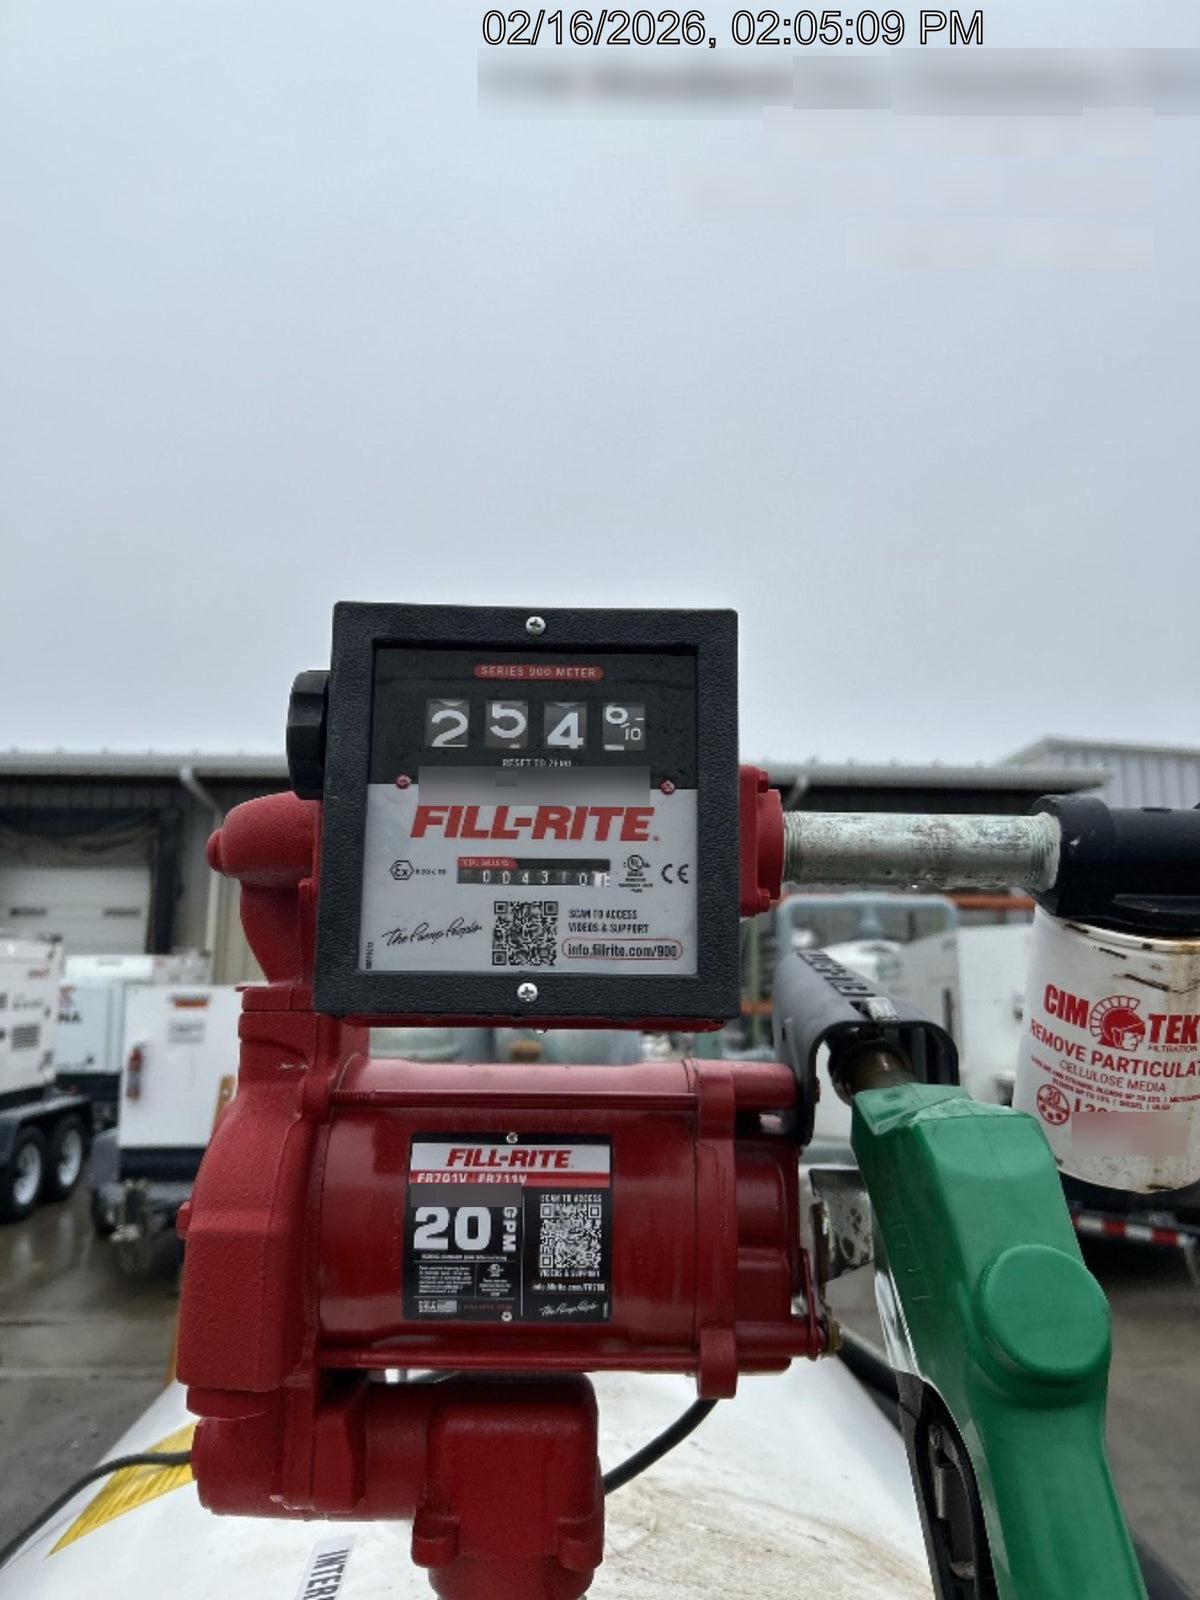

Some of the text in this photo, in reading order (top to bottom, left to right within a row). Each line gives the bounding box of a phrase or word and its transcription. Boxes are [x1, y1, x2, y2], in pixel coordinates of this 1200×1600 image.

[481, 666, 523, 677] SERIES
[556, 667, 596, 678] METER
[410, 804, 656, 842] FILL-RITE
[568, 908, 638, 920] SCAN TO ACCESS
[568, 922, 599, 933] VIDEOS
[609, 923, 649, 934] SUPPORT
[1043, 984, 1200, 1044] CIM TEK
[1030, 1018, 1087, 1063] REMOVE
[1060, 1059, 1124, 1089] CELLULOSE
[1126, 1078, 1166, 1093] MEDIA
[446, 1148, 572, 1168] FILL-RITE
[413, 1206, 492, 1251] 20
[502, 1206, 518, 1253] GPM
[302, 1548, 350, 1600] INTER
